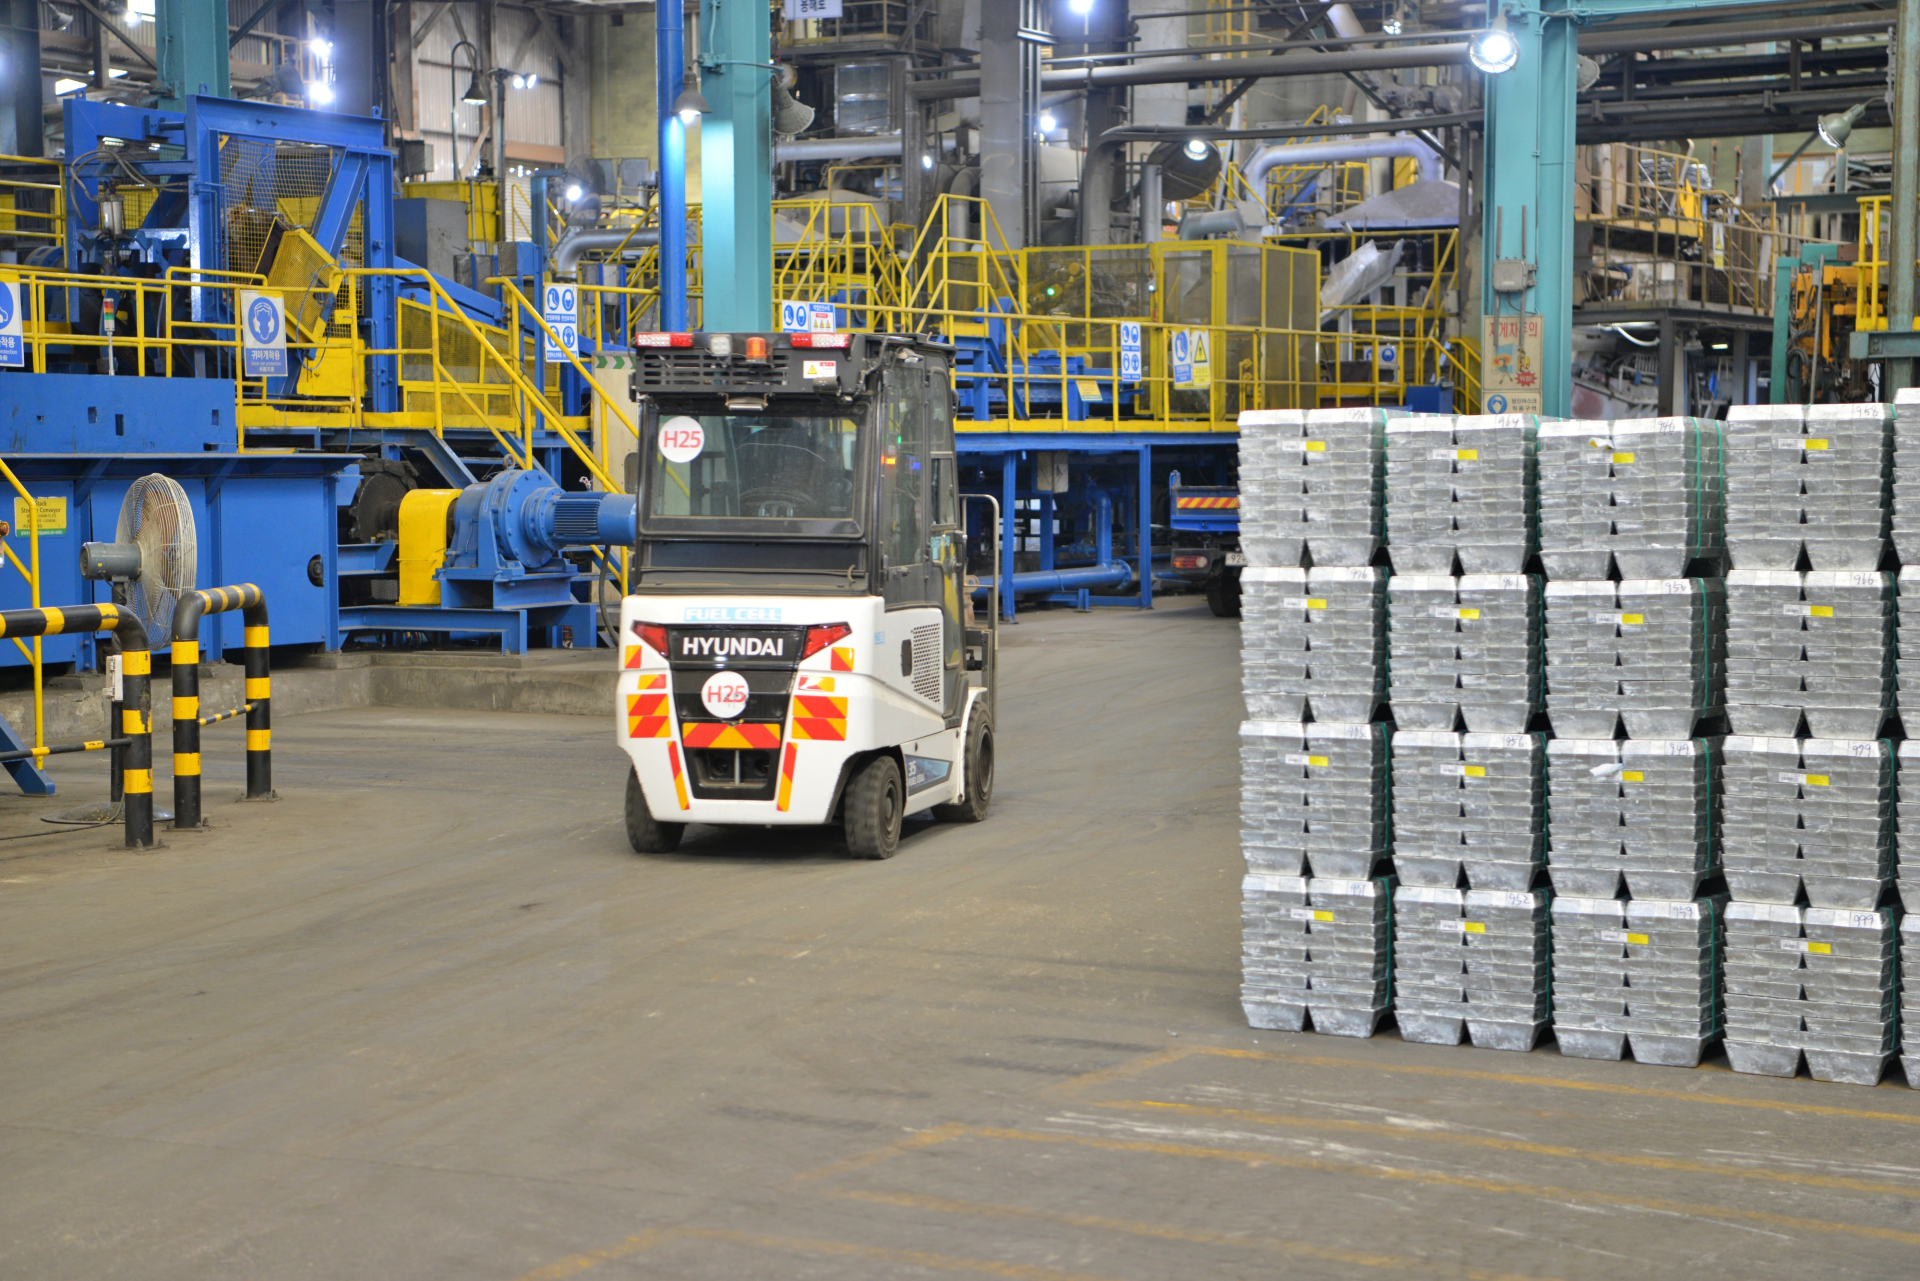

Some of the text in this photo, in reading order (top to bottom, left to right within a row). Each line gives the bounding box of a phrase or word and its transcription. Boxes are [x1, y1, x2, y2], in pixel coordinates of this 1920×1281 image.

[663, 430, 701, 448] H25
[685, 608, 781, 621] FUEL CELL
[682, 637, 783, 656] HYUNDAI
[707, 685, 746, 703] H25
